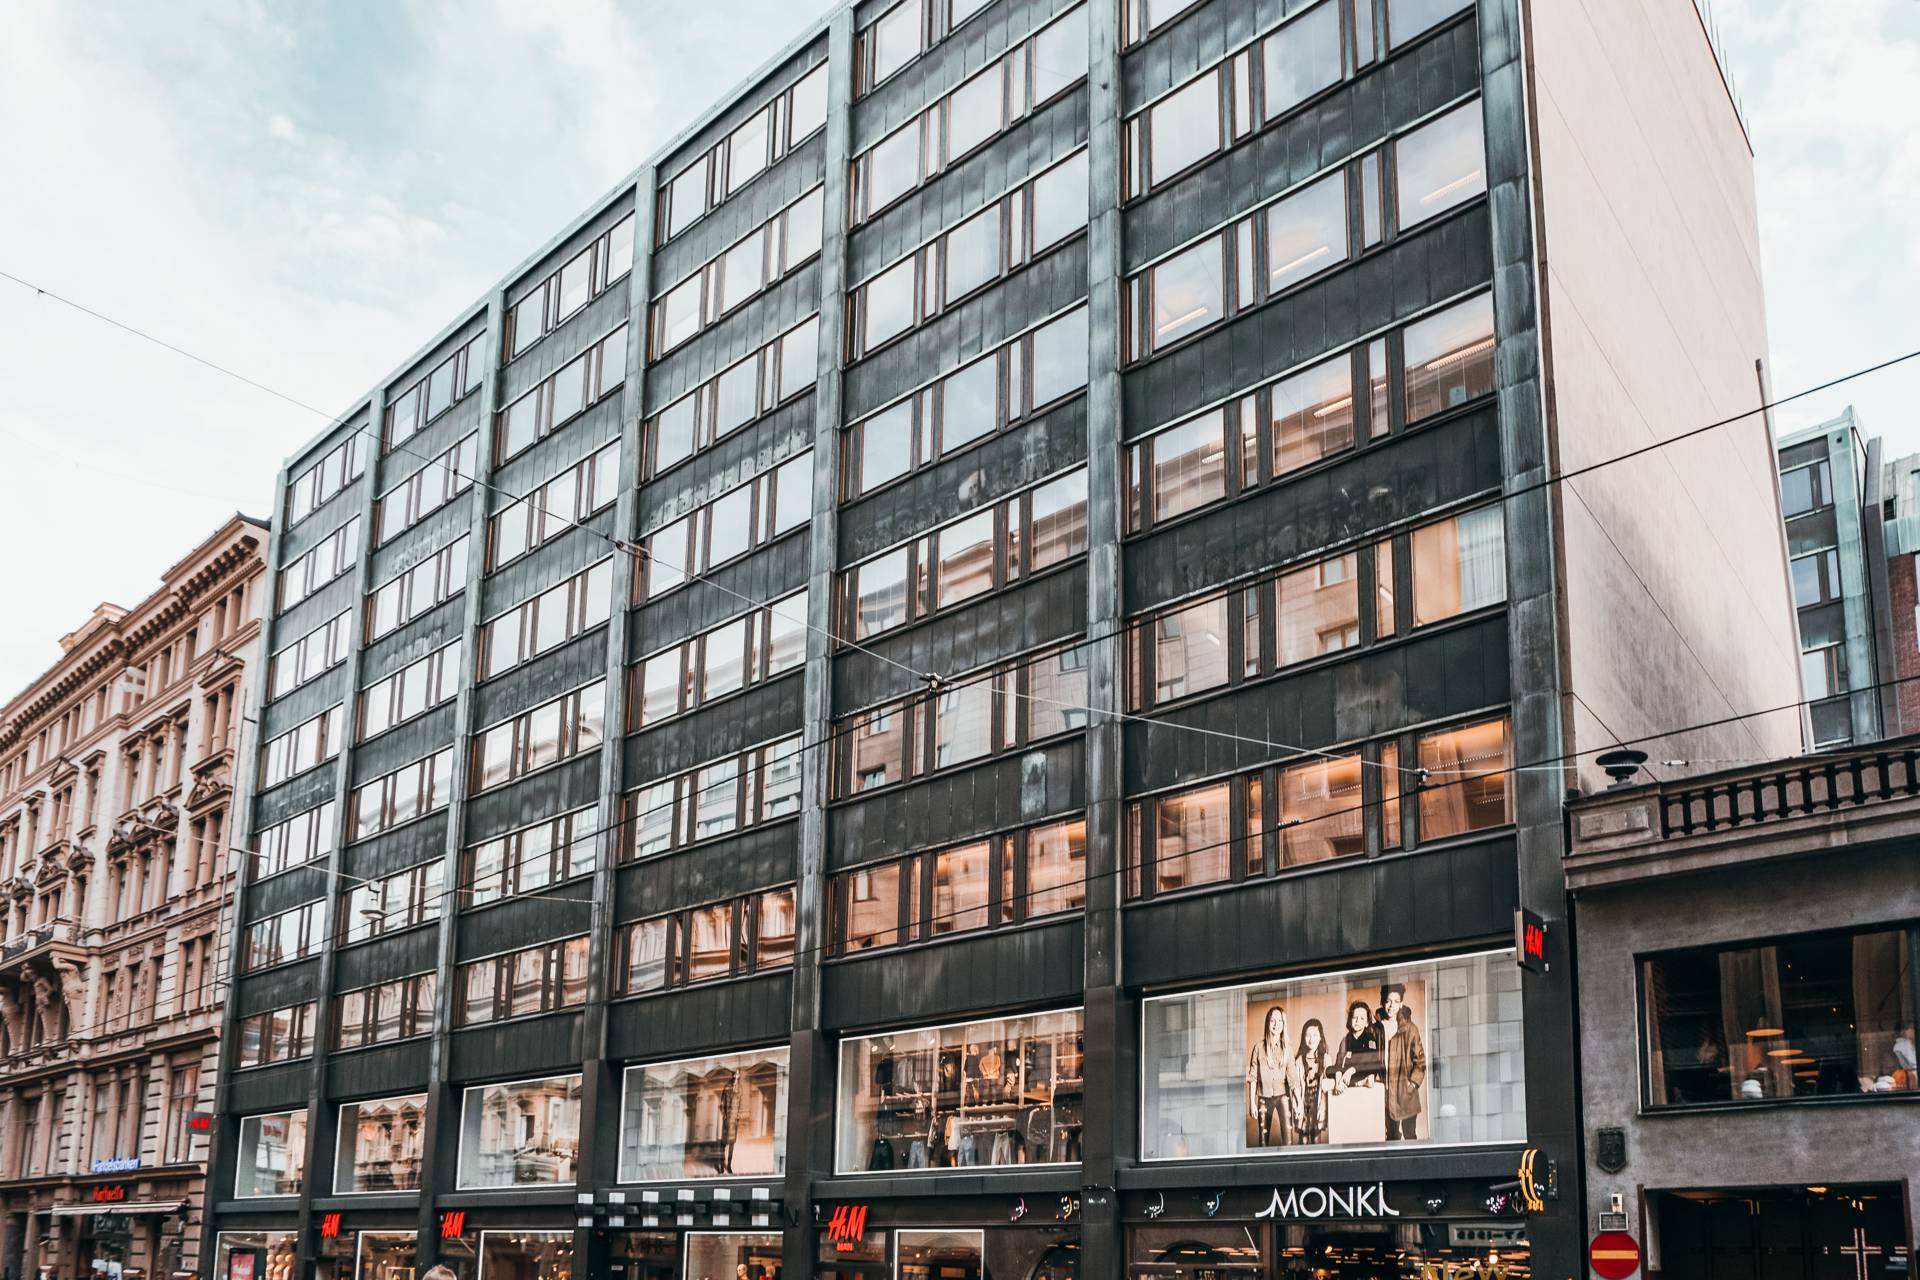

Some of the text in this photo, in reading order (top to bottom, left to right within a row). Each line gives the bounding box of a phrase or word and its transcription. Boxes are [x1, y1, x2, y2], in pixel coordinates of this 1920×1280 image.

[1525, 922, 1543, 961] H&M
[1255, 1181, 1400, 1218] MONKI
[441, 1211, 465, 1239] H&M
[828, 1205, 867, 1242] H&M
